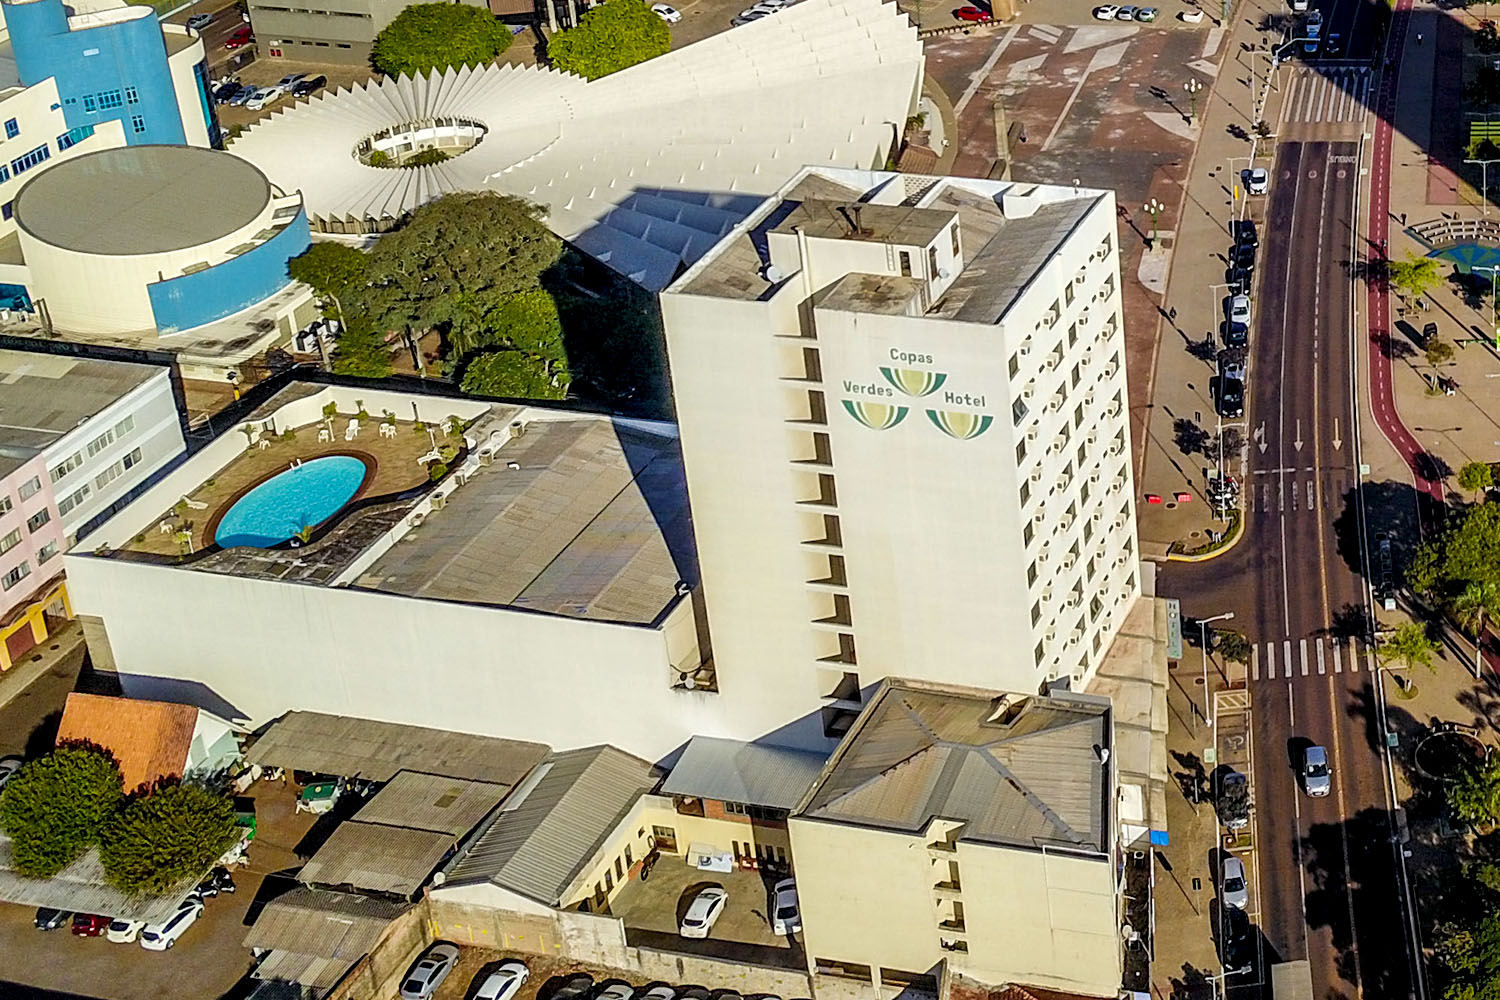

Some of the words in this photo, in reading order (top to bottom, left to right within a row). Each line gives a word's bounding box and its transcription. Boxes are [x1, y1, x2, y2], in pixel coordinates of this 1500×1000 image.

[890, 348, 933, 365] Copas
[843, 380, 894, 397] Verdes
[945, 391, 986, 408] Hotel
